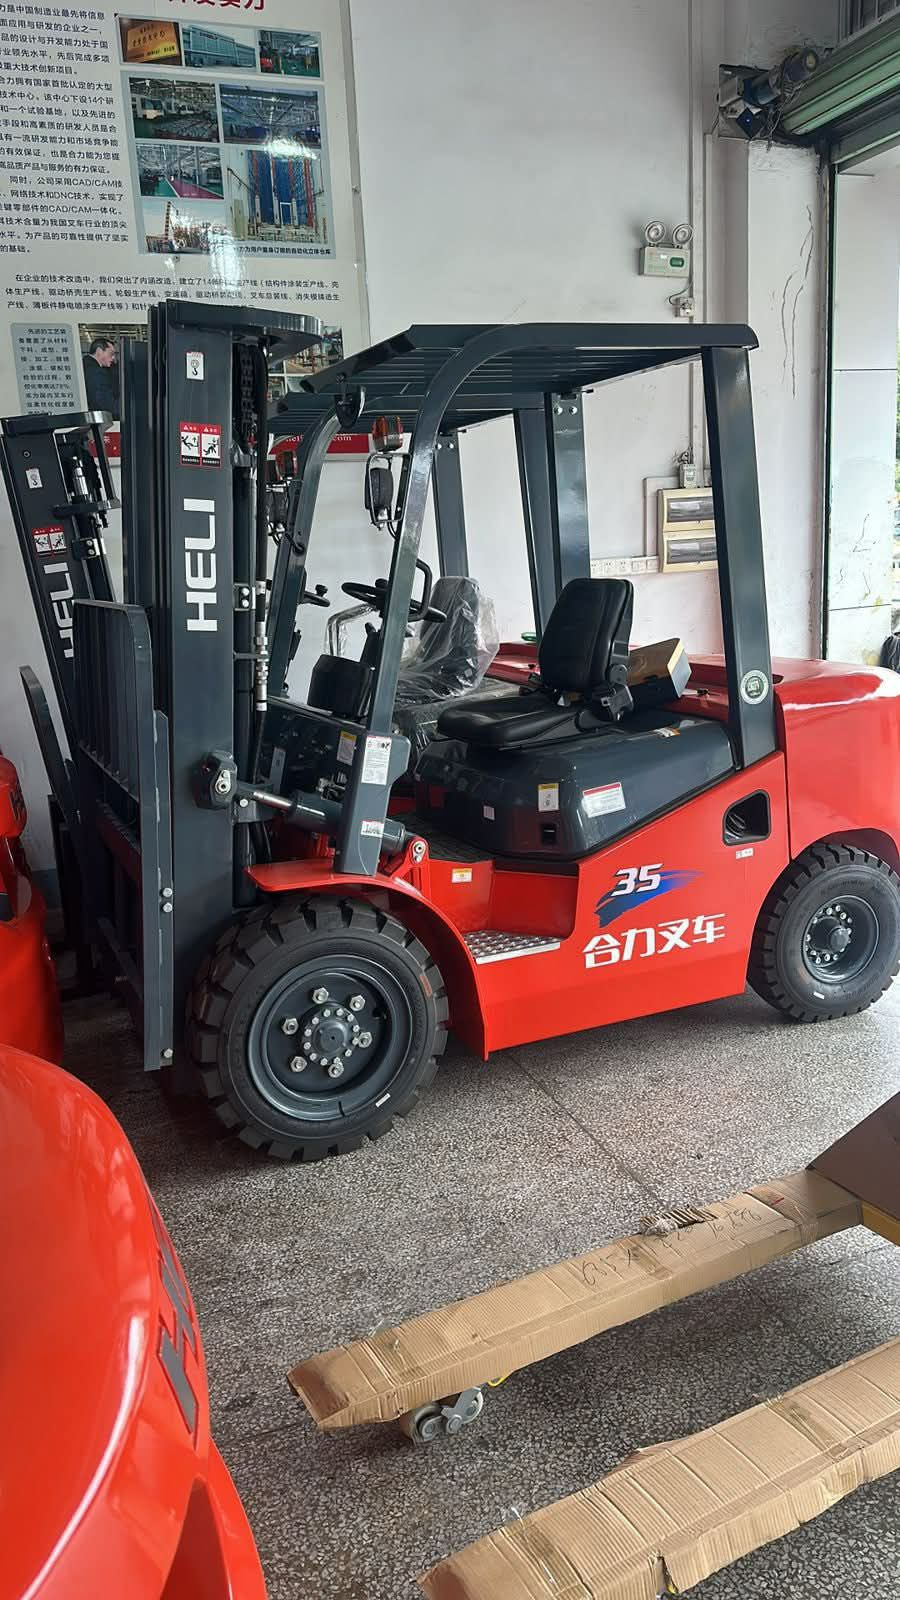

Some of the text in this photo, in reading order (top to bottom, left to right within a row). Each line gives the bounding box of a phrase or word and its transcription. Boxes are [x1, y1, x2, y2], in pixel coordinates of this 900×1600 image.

[0, 48, 110, 63] 业领先水平，先后完成多项
[0, 63, 78, 75] 重大技术创新项目。
[0, 119, 117, 133] 手段和高素质的研发人员是合
[183, 498, 218, 632] HELI
[610, 863, 664, 897] 35
[582, 913, 726, 969] 合力叉车
